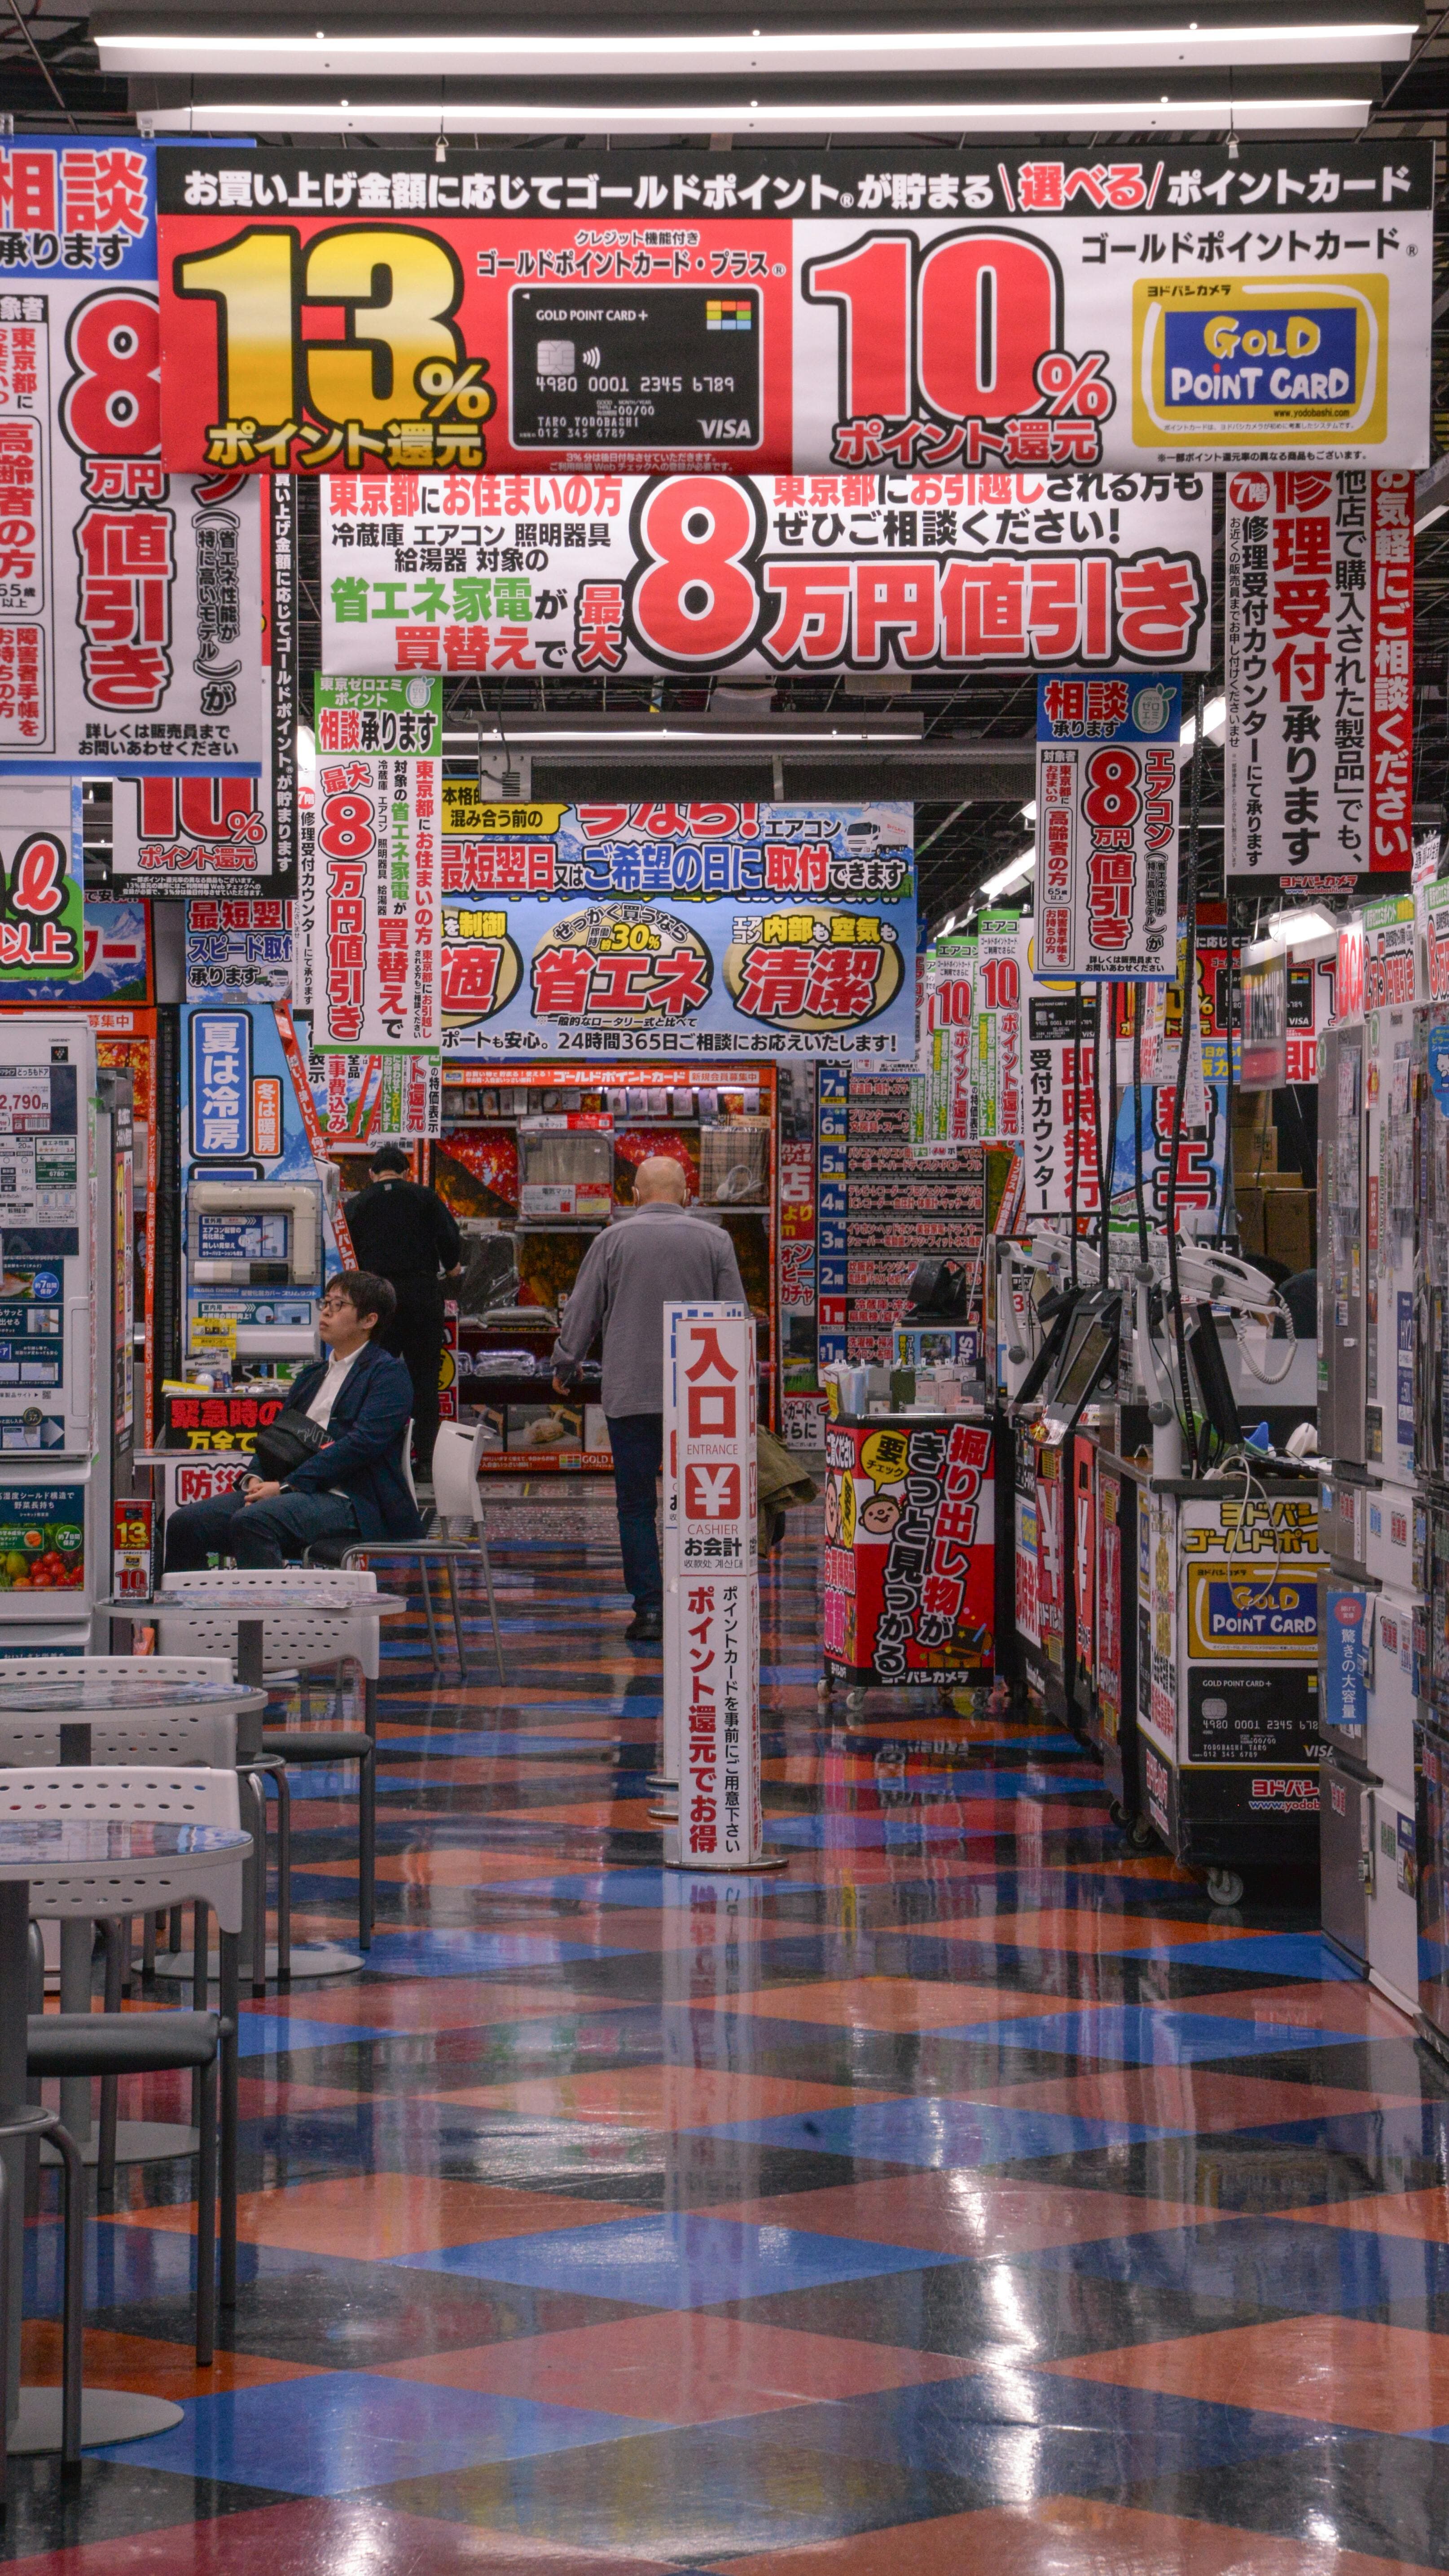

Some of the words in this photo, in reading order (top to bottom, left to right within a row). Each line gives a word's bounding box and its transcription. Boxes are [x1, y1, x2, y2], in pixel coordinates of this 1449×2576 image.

[1016, 162, 1147, 211] 選べる
[1167, 166, 1411, 206] ポイントカード
[575, 230, 700, 247] クレジット機能付き
[1147, 283, 1232, 298] ヨドバシカメラ
[174, 223, 496, 431] 13%
[536, 310, 567, 321] GOLD
[570, 310, 600, 321] POINT
[602, 310, 637, 321] CARD
[802, 225, 1117, 422] 10%
[1203, 315, 1321, 360] GOLD
[12, 327, 37, 409] 東京都に
[1171, 364, 1264, 403] POINT
[1269, 366, 1350, 400] CARD
[536, 377, 578, 392] 4980
[588, 377, 629, 392] 0001
[641, 377, 682, 392] 2345
[693, 377, 734, 392] 6789
[537, 417, 566, 427] TARO
[575, 417, 639, 427] YODOBASHI
[618, 406, 655, 416] 00/00
[1273, 407, 1350, 418] www.yodobashi.com
[205, 420, 486, 469] ポイント還元
[538, 428, 559, 438] 012
[567, 428, 588, 438] 345
[596, 428, 625, 438] 6789
[697, 419, 751, 439] VISA
[832, 417, 1101, 468] ポイント還元
[329, 474, 623, 517] 東京都にお住まいの方
[773, 474, 1203, 506] 東京都にお引越しされる方も
[331, 523, 404, 547] 冷蔵庫
[413, 525, 505, 546] エアコン
[515, 523, 611, 548] 照明器具
[395, 548, 467, 573] 給湯器
[477, 548, 549, 573] 対象の
[197, 529, 219, 662] 特に高いモデル
[217, 529, 239, 644] 省エネ性能が
[330, 577, 568, 623] 省エネ家電が
[2, 598, 28, 608] 以上
[1229, 517, 1240, 748] お近くの販売員までお申し付けくださいませ
[395, 626, 566, 672] 買替えで
[320, 676, 403, 693] 東京ゼロエミ
[334, 693, 388, 707] ポイント
[1044, 680, 1129, 722] 相談
[1142, 702, 1160, 711] ゼロ
[85, 724, 231, 740] 詳しくは販売員まで
[320, 709, 437, 753] 相談承ります
[1052, 720, 1119, 738] 承ります
[78, 740, 239, 756] お問いあわせください
[1044, 750, 1076, 763] 対象者
[378, 760, 387, 791] 冷蔵庫
[1045, 765, 1058, 803] お住まいの
[1059, 765, 1072, 804] 東京都に
[378, 797, 387, 832] エアコン
[1144, 749, 1176, 850] エアコン
[450, 809, 543, 828] 混み合う前の
[765, 820, 842, 838] エアコン
[391, 760, 410, 915] 対象の省エネ家電が
[415, 760, 434, 945] 東京都にお住まいの方
[1048, 810, 1069, 887] 高齢者の方
[378, 838, 387, 879] 照明器具
[1145, 861, 1157, 926] 特に高いモデル
[1156, 861, 1167, 917] 省エネ性能が
[1280, 875, 1358, 888] ヨドバシカメラ
[1285, 887, 1353, 896] www.yodobashi.com
[377, 885, 387, 916] 給湯器
[553, 903, 689, 943] せっかく買うなら
[764, 916, 898, 944] 内部も空気も
[1045, 910, 1057, 954] お持ちの方
[1057, 909, 1067, 963] 障害者手帳を
[1085, 964, 1165, 972] お問いあわせください
[1089, 956, 1160, 964] 詳しくは販売員まで
[189, 967, 260, 987] 承ります
[534, 947, 710, 1016] 省エネ
[736, 947, 882, 1016] 清潔
[413, 950, 422, 1039] される方もご相談ください
[421, 950, 433, 1039] 東京都にお引越し
[536, 1017, 697, 1028] ※一般的なロータリー式と比べて
[202, 1022, 240, 1150] 夏は冷房
[553, 1071, 685, 1083] ゴールドポイントカード
[691, 1071, 757, 1082] 新規会員募集中
[952, 1029, 970, 1141] ポイント還元
[1001, 1012, 1019, 1136] ポイント還元
[428, 1067, 439, 1133] の特価表示
[257, 1083, 276, 1153] 冬は暖房
[1030, 1048, 1054, 1211] 受付カウンター
[1062, 1047, 1102, 1209] 即時発行
[684, 1327, 739, 1439] 入口
[171, 1399, 284, 1429] 緊急時の
[582, 1456, 608, 1464] GOLD
[687, 1444, 738, 1455] ENTRANCE
[866, 1460, 905, 1478] チェック
[14, 1501, 55, 1510] 野菜長持ち
[58, 1531, 81, 1540] 約7日間
[116, 1522, 149, 1544] 13%
[688, 1524, 738, 1535] CASHIER
[917, 1422, 992, 1648] 掘り出し物が
[684, 1537, 742, 1557] お会計
[873, 1431, 946, 1676] きっと見つかる
[684, 1559, 713, 1569] 收款处
[715, 1559, 743, 1569] 계산대
[115, 1568, 149, 1592] 10%
[1231, 1587, 1300, 1611] GOLD
[1213, 1612, 1266, 1634] POINT
[1270, 1614, 1317, 1634] CARD
[1341, 1628, 1357, 1719] 驚きの大容量
[687, 1586, 718, 1854] ポイント還元でお得
[723, 1585, 741, 1853] ポイントカードを事前にご用意下さい
[1203, 1720, 1229, 1729] 4980
[1234, 1720, 1260, 1729] 0001
[1267, 1720, 1293, 1729] 2345
[1252, 1780, 1319, 1797] ヨドバシ
